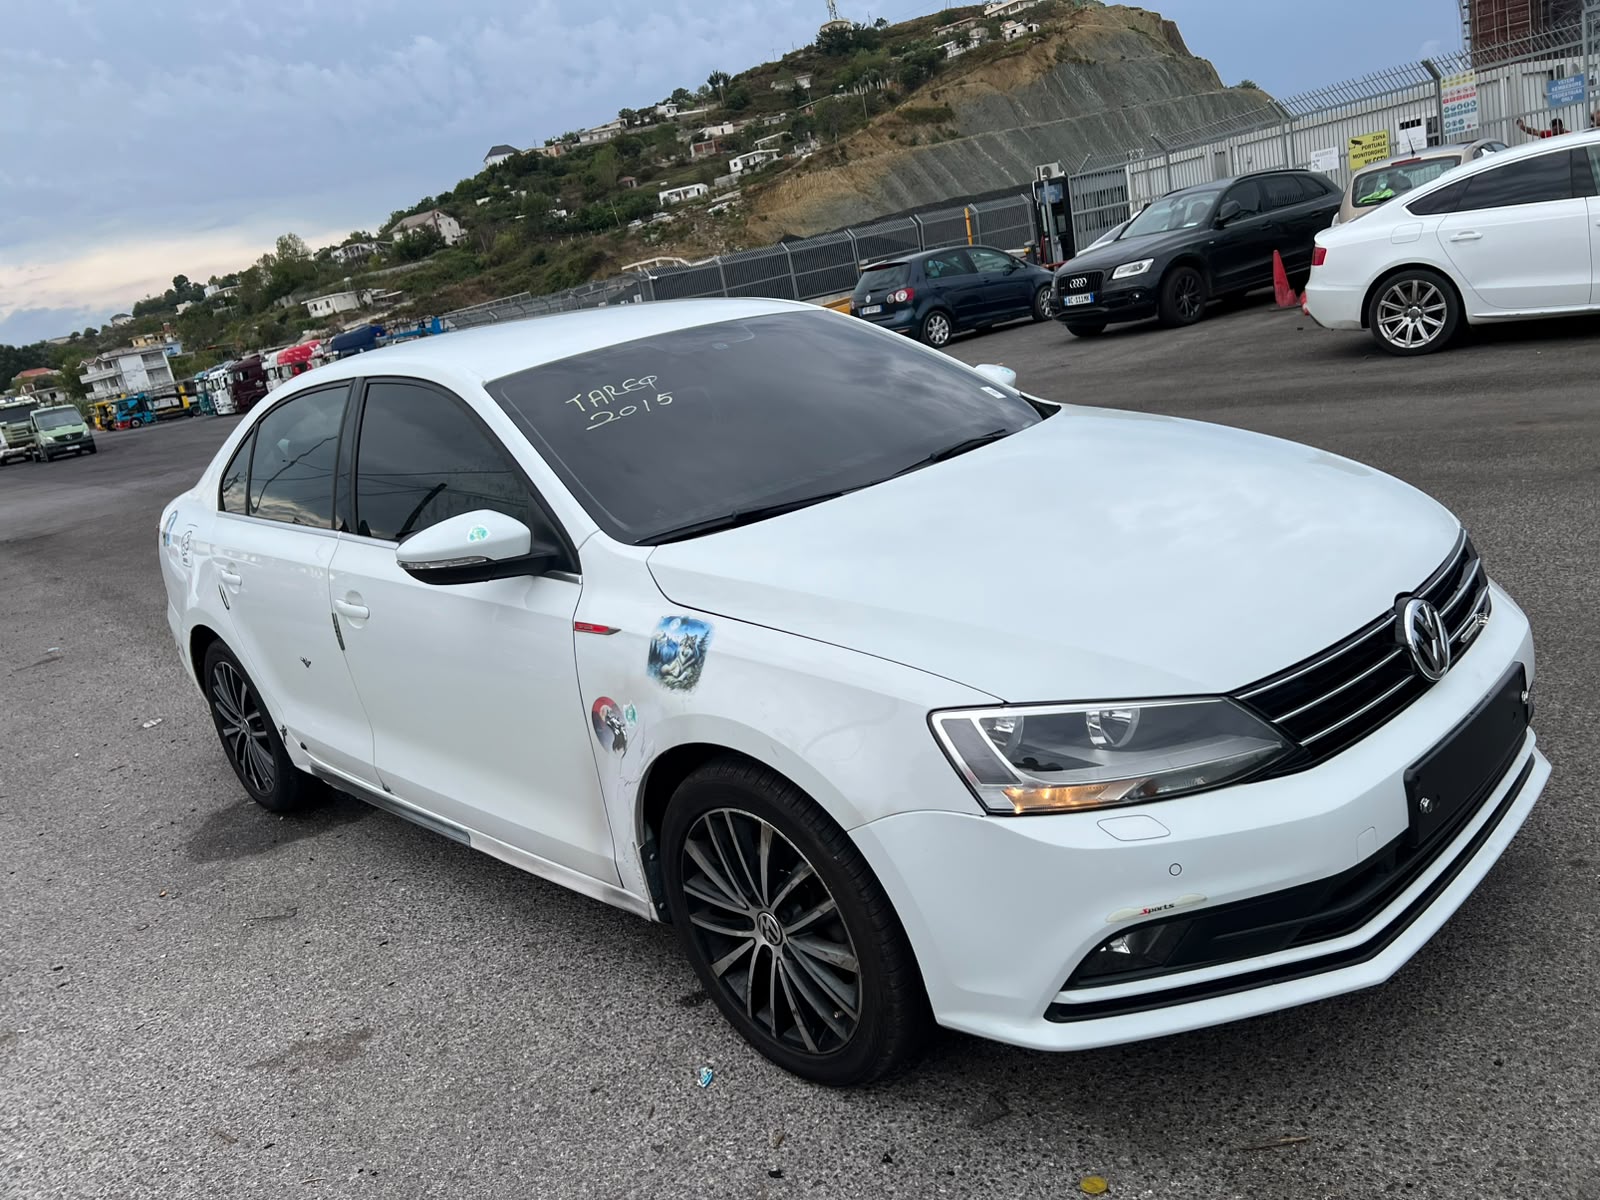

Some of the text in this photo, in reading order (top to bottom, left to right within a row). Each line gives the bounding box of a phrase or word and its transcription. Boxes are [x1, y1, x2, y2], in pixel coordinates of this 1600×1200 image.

[1372, 133, 1386, 141] ZONA
[1361, 141, 1387, 151] PORTUALE
[1352, 147, 1387, 159] MONITOROHET
[586, 391, 673, 431] 2015
[1139, 903, 1175, 915] Sports
